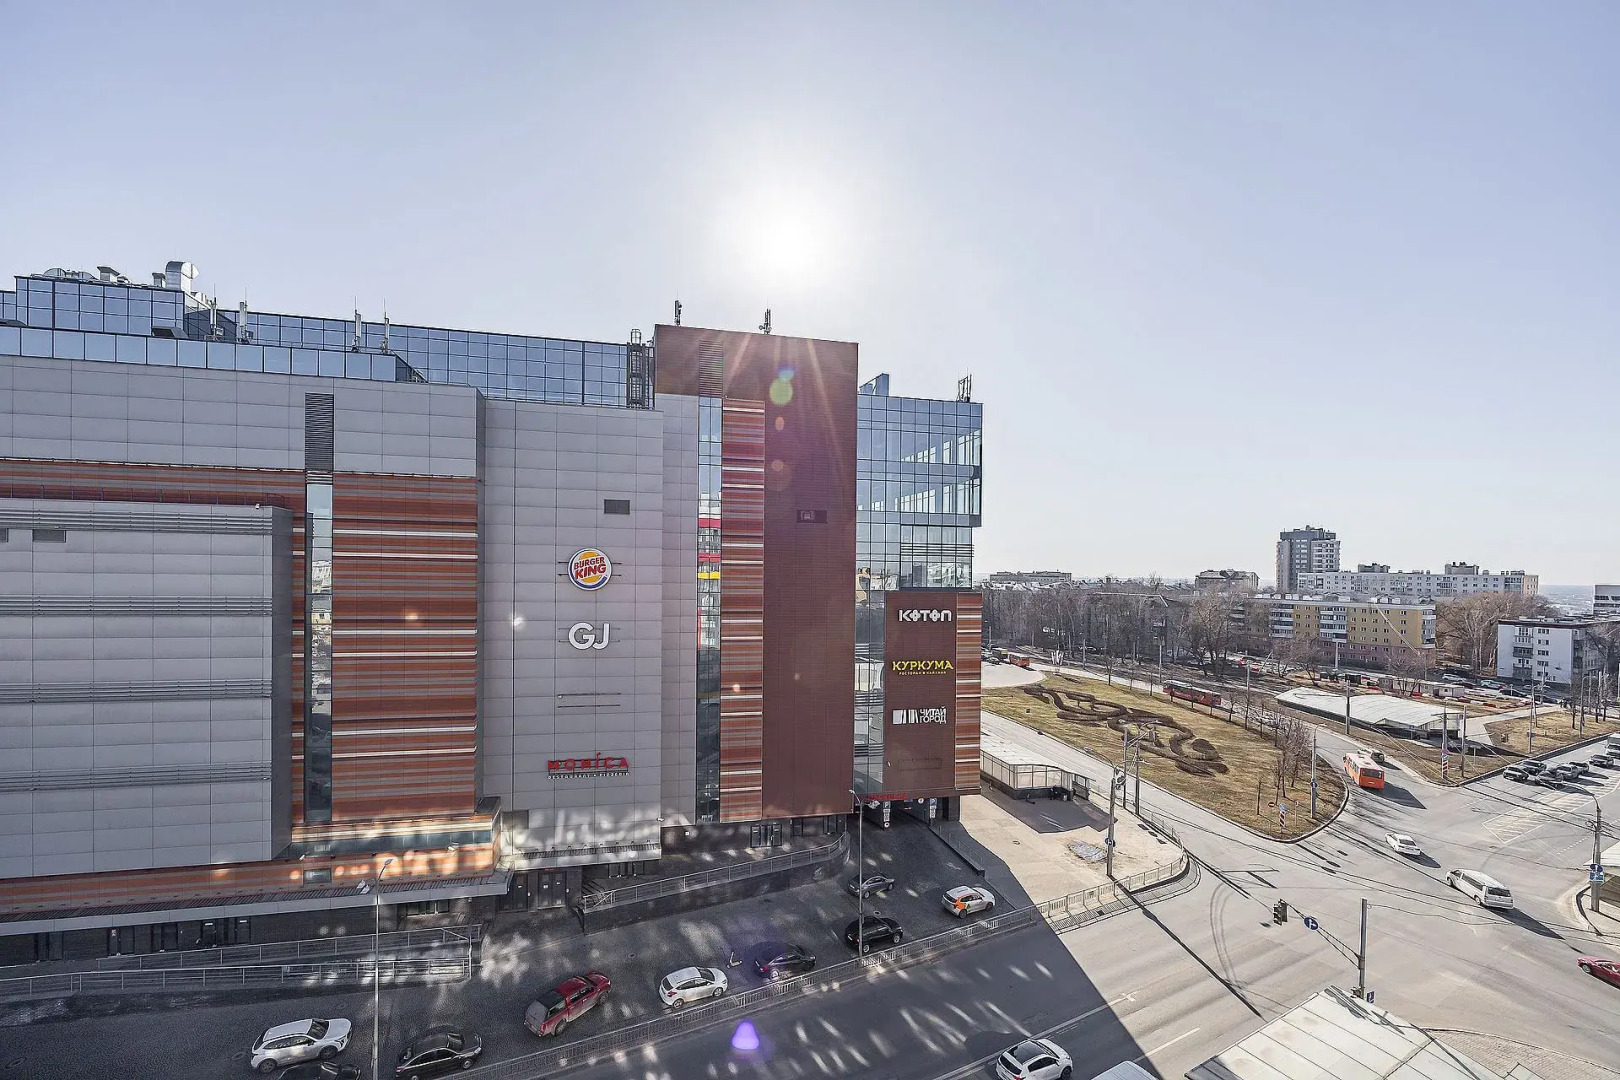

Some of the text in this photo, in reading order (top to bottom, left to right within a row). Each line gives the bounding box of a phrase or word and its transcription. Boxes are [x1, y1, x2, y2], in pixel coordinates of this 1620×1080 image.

[573, 557, 606, 570] BURGER
[574, 563, 607, 580] KING
[568, 622, 610, 650] GJ
[892, 660, 954, 671] КУРКУМА
[920, 705, 947, 716] ЧИТАЙ
[920, 715, 947, 724] ГОРОД
